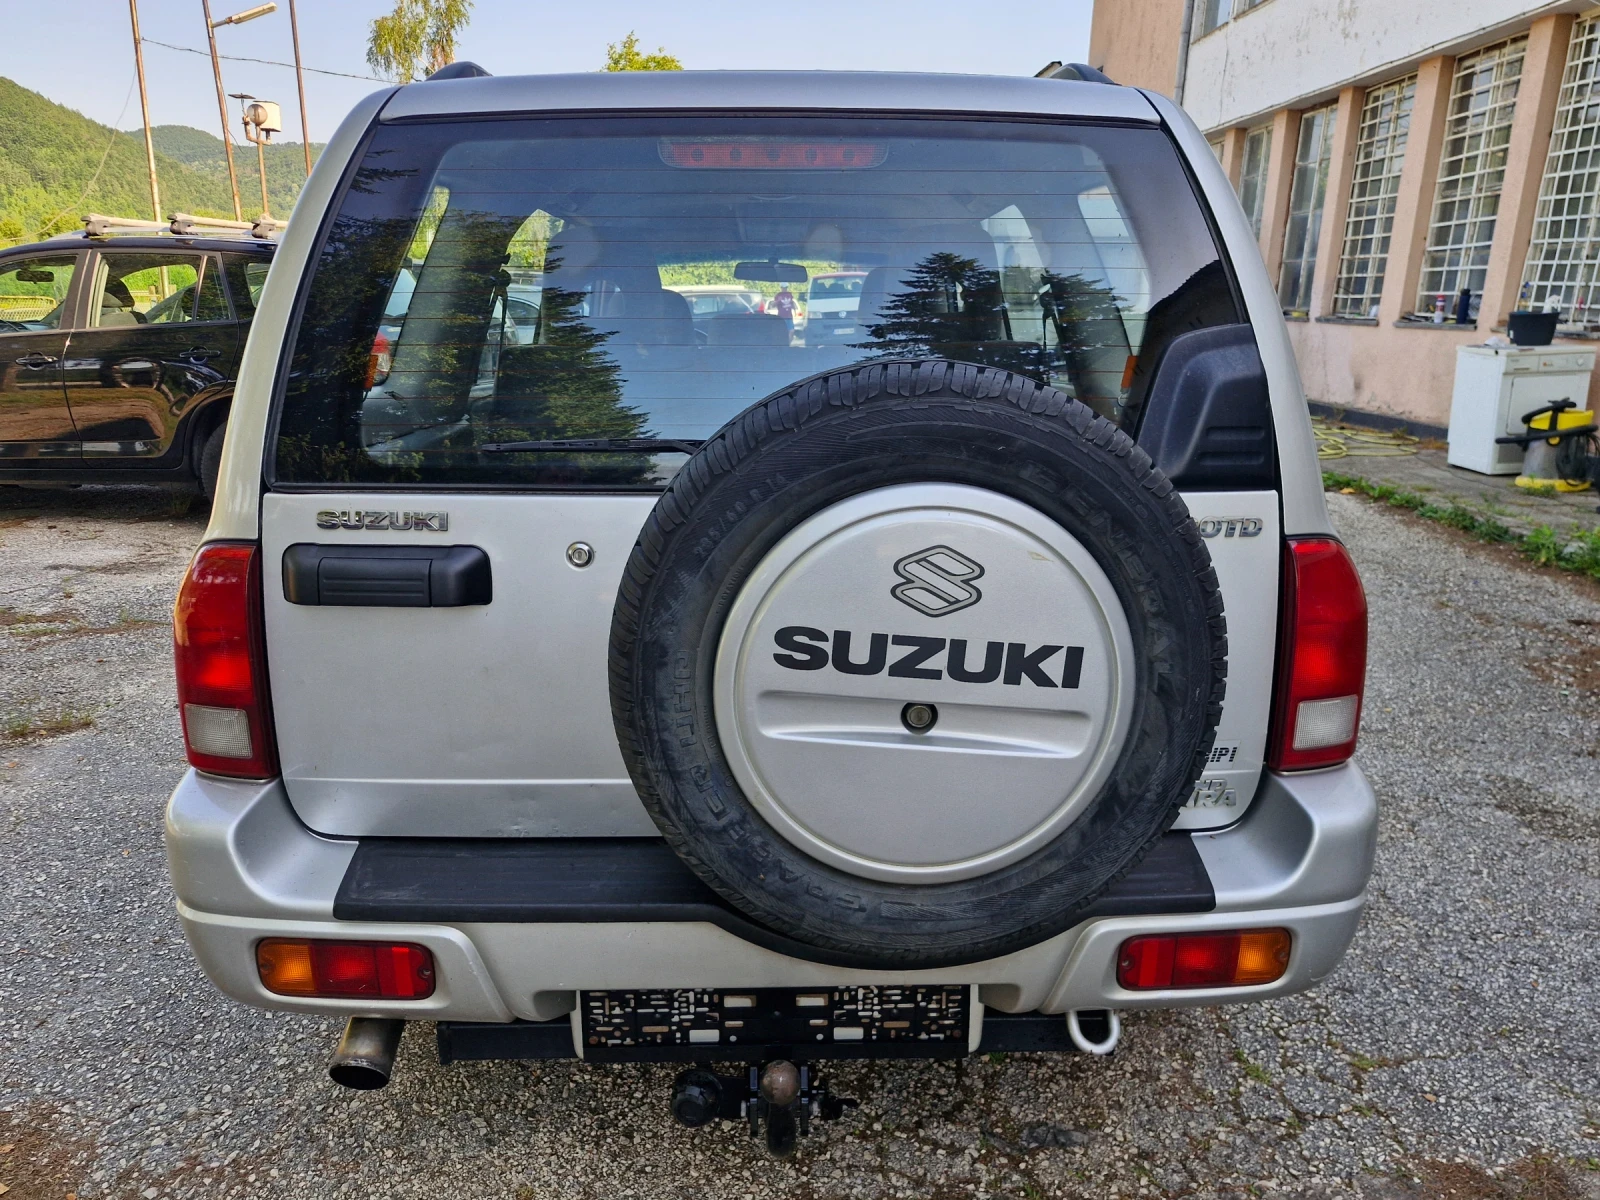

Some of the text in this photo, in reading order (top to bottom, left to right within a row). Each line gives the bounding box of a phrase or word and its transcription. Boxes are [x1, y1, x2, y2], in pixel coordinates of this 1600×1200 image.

[317, 510, 448, 531] SUZUKI
[1018, 458, 1178, 694] GENERAL
[773, 626, 1085, 688] SUZUKI
